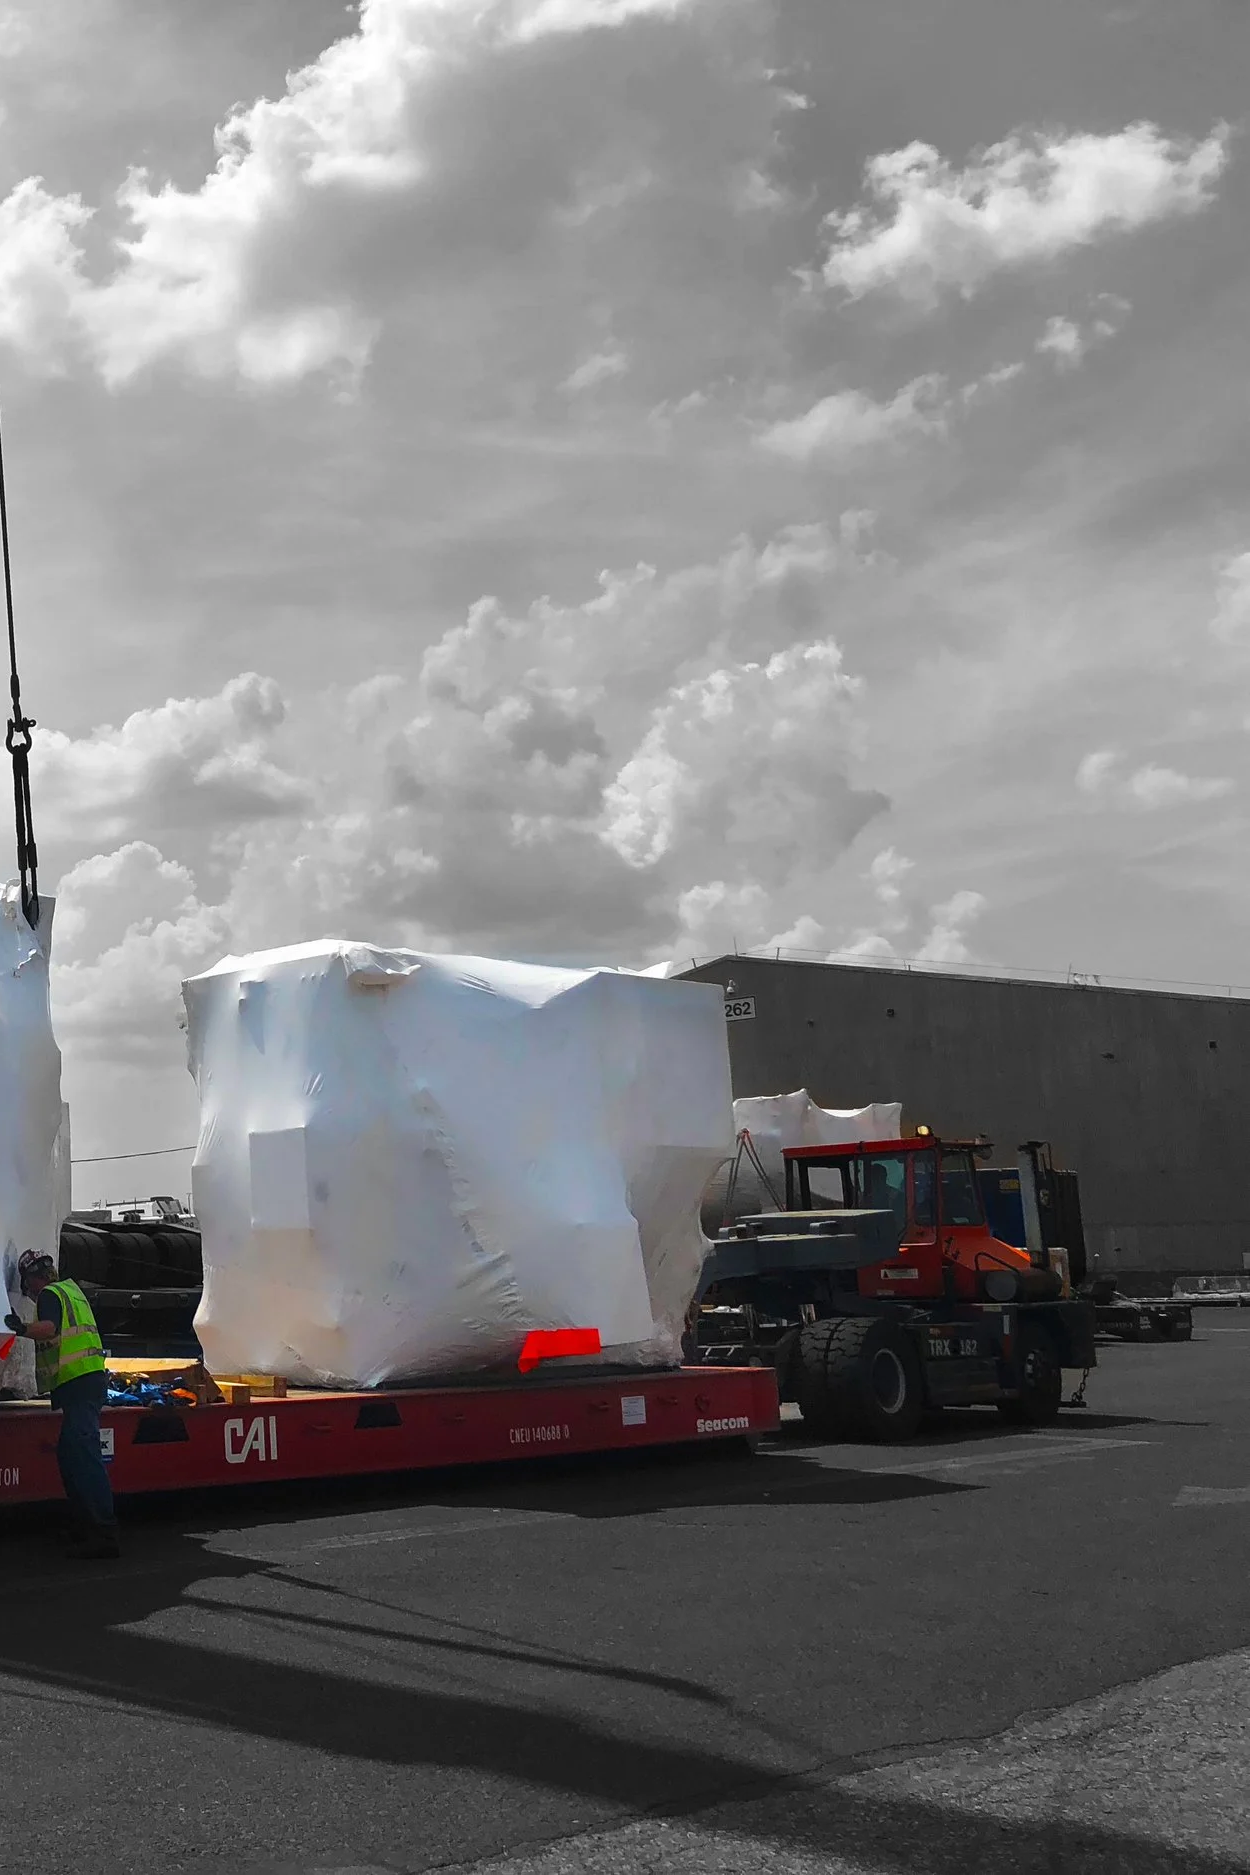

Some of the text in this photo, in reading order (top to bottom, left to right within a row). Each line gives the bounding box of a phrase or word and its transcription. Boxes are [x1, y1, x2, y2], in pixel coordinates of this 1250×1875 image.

[724, 1001, 752, 1018] 262
[928, 1339, 951, 1356] TRX
[696, 1415, 750, 1433] Seacom
[224, 1415, 278, 1464] CAI
